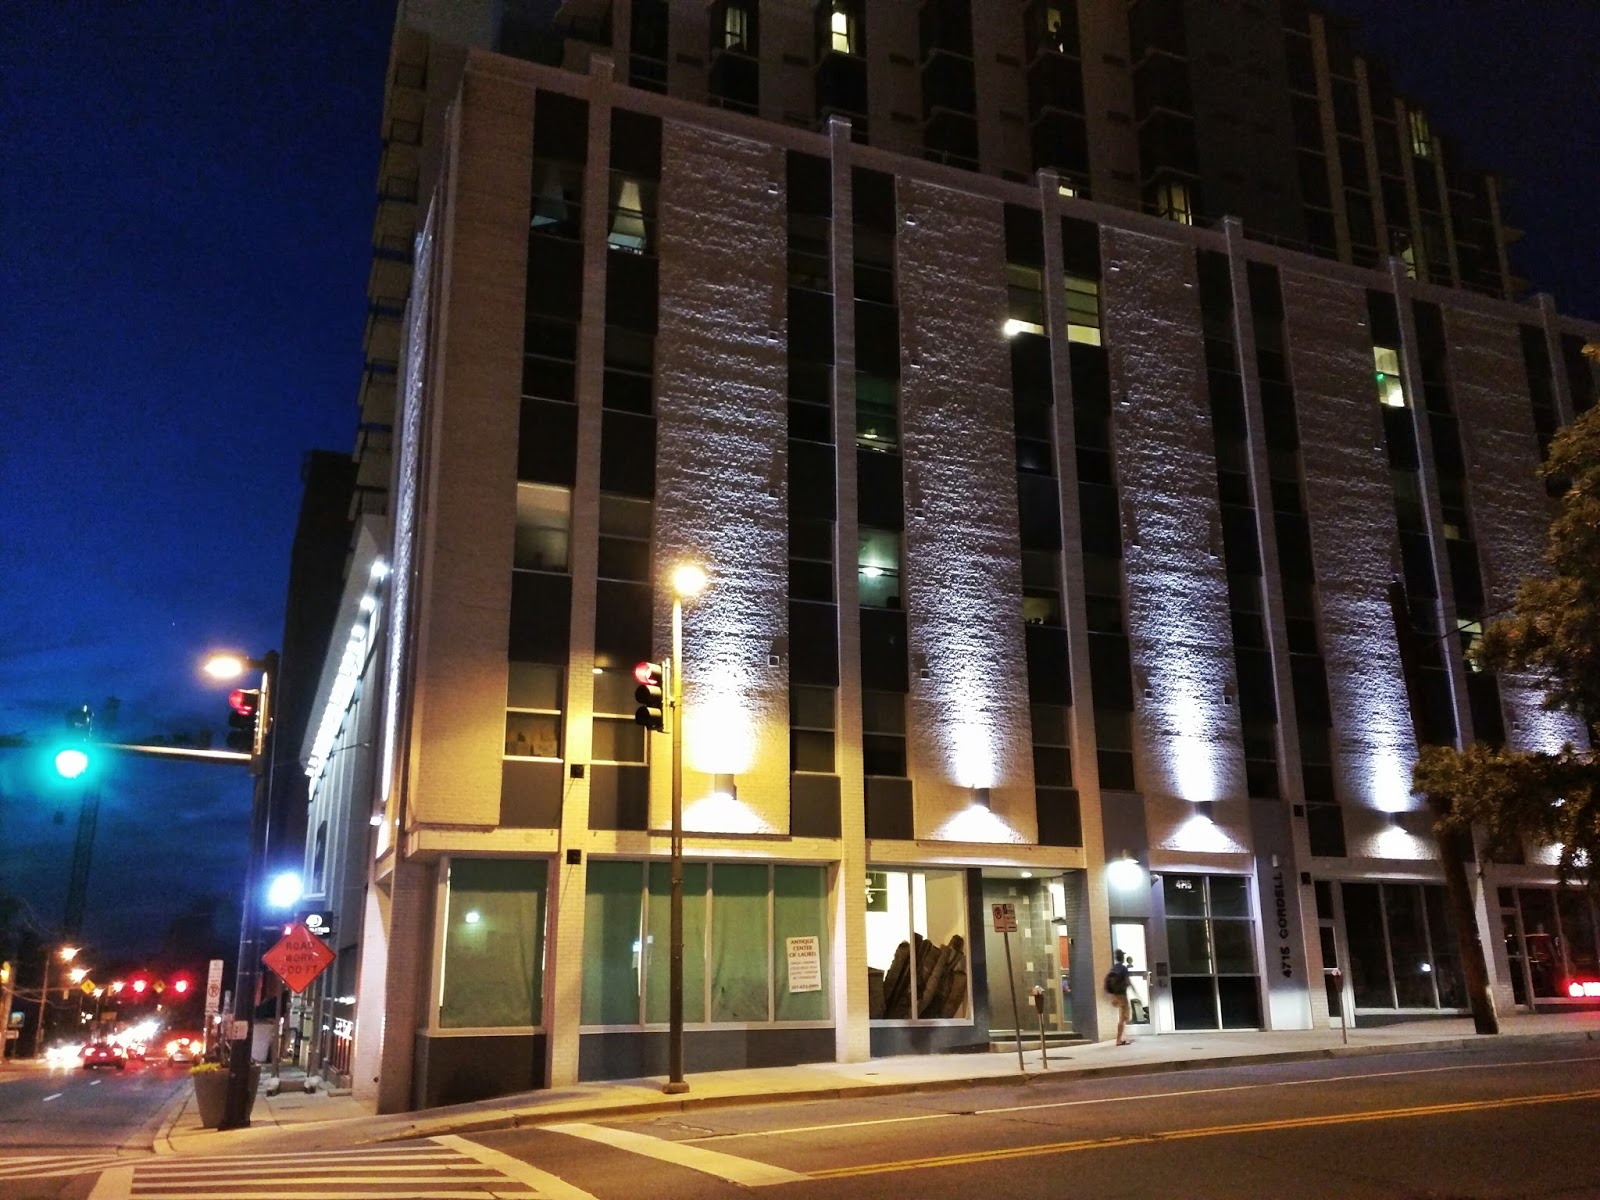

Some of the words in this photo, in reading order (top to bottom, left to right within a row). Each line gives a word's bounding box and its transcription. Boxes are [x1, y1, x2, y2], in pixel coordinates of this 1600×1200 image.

[1273, 872, 1289, 939] CORDELL
[286, 942, 315, 950] ROAD
[286, 953, 313, 962] WORK
[1281, 946, 1292, 978] 4715
[280, 965, 302, 975] 500
[306, 965, 318, 974] FT
